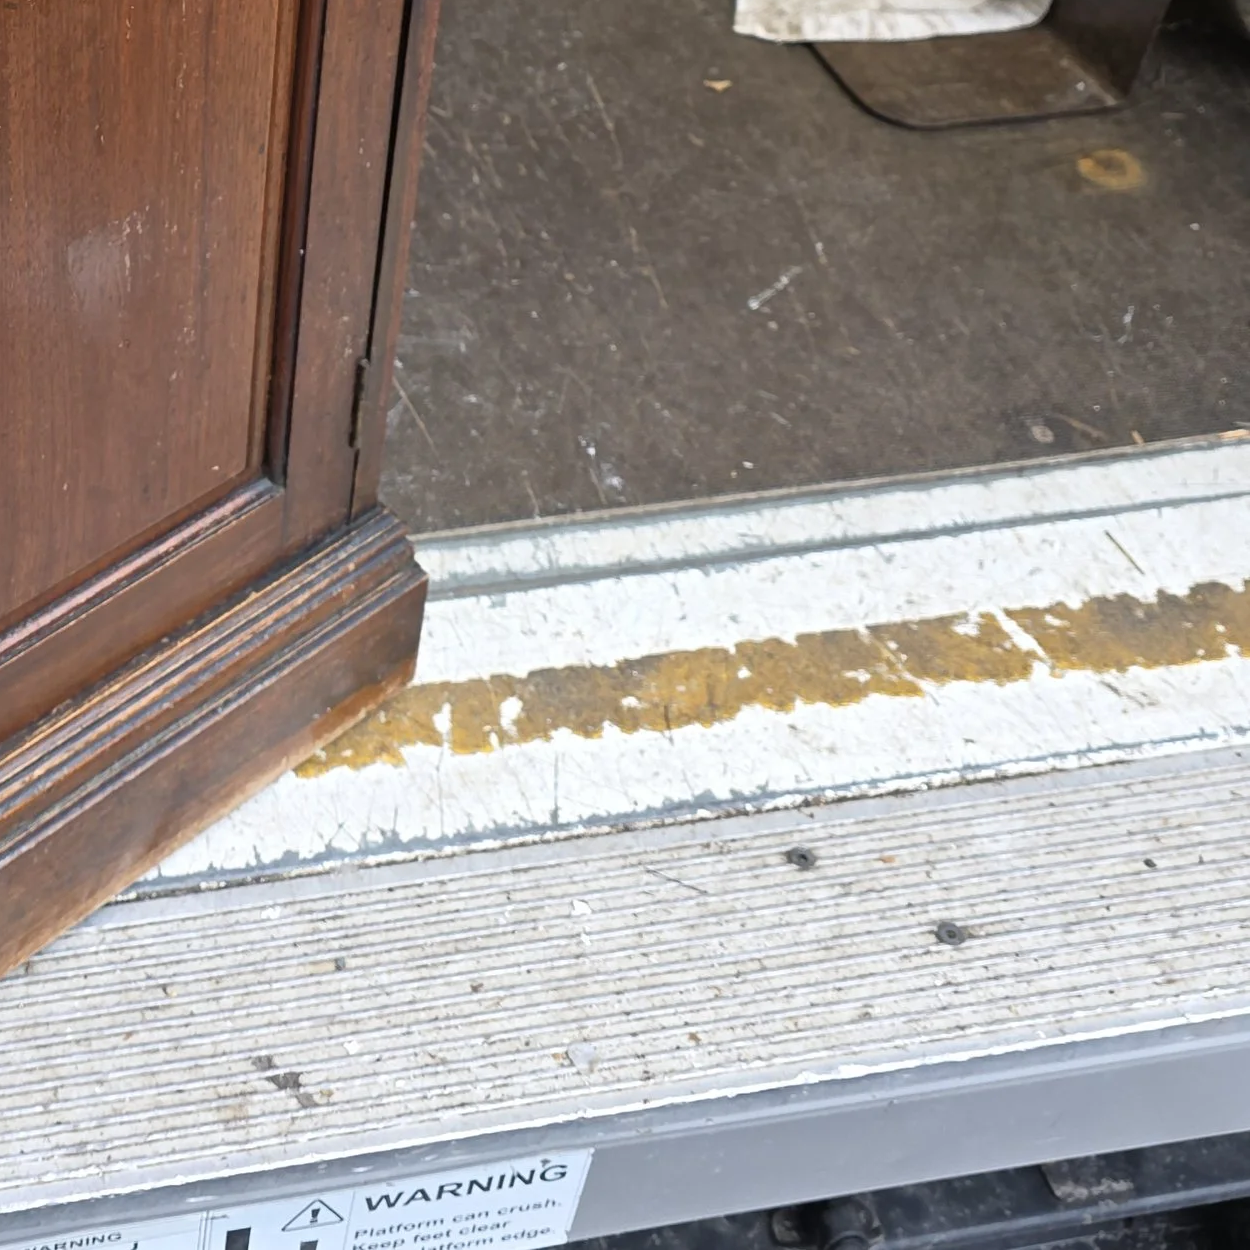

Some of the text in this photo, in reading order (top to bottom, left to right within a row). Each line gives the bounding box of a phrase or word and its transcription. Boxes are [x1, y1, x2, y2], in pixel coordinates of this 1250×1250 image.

[365, 1165, 568, 1211] WARNING
[352, 1221, 511, 1250] Keep feet clear
[354, 1218, 445, 1239] Platform
[452, 1211, 490, 1223] can
[24, 1232, 122, 1250] ARNING
